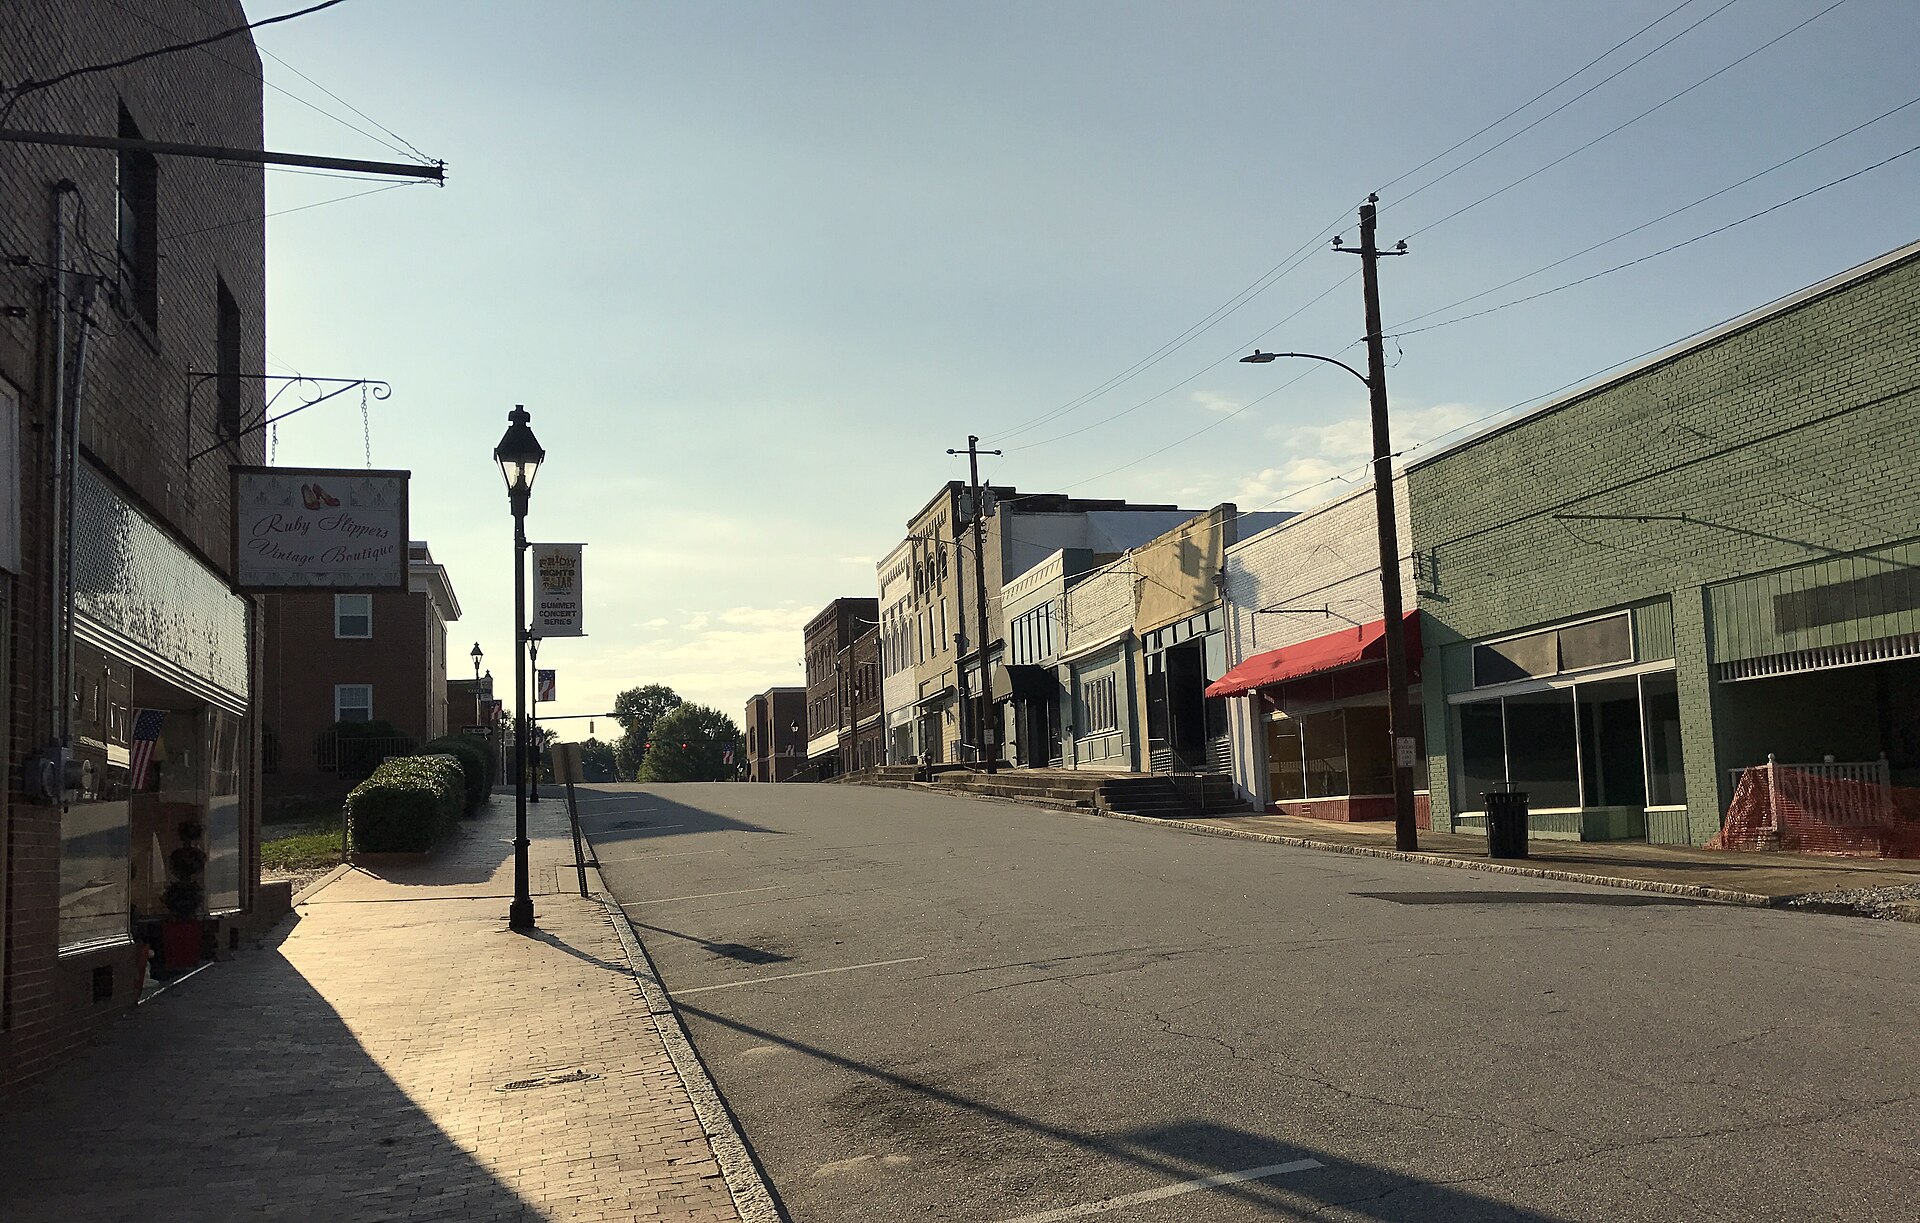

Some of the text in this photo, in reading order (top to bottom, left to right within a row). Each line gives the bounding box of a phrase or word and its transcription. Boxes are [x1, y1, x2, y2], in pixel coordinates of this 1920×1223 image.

[252, 512, 390, 539] Ruby Slippers
[247, 538, 394, 567] Vintage Boutique
[540, 569, 575, 577] NIGHTS
[539, 610, 577, 618] CONCERT
